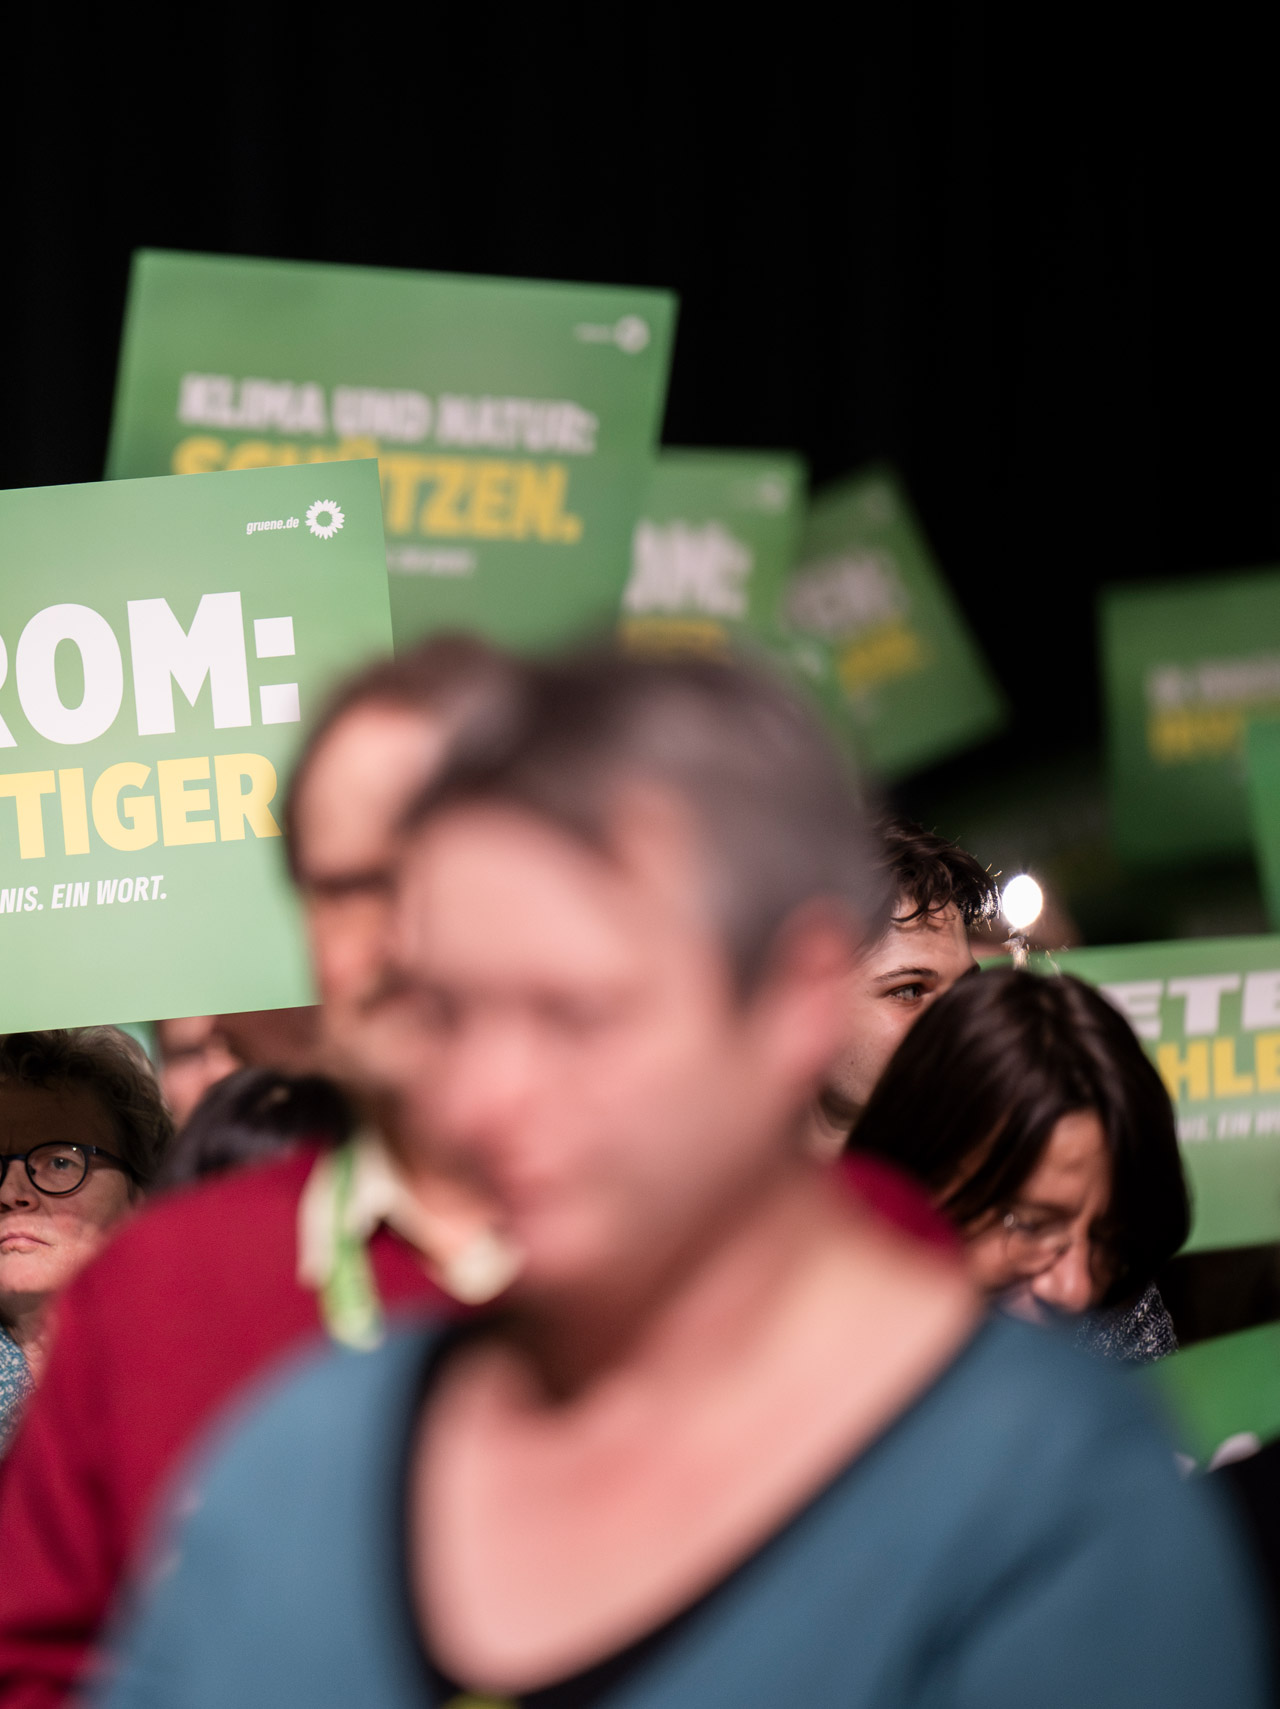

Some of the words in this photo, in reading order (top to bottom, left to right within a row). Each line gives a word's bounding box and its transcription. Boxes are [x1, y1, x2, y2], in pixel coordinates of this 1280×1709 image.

[246, 516, 300, 535] gruene.de
[51, 881, 90, 909] EIN
[96, 875, 168, 905] WORT.
